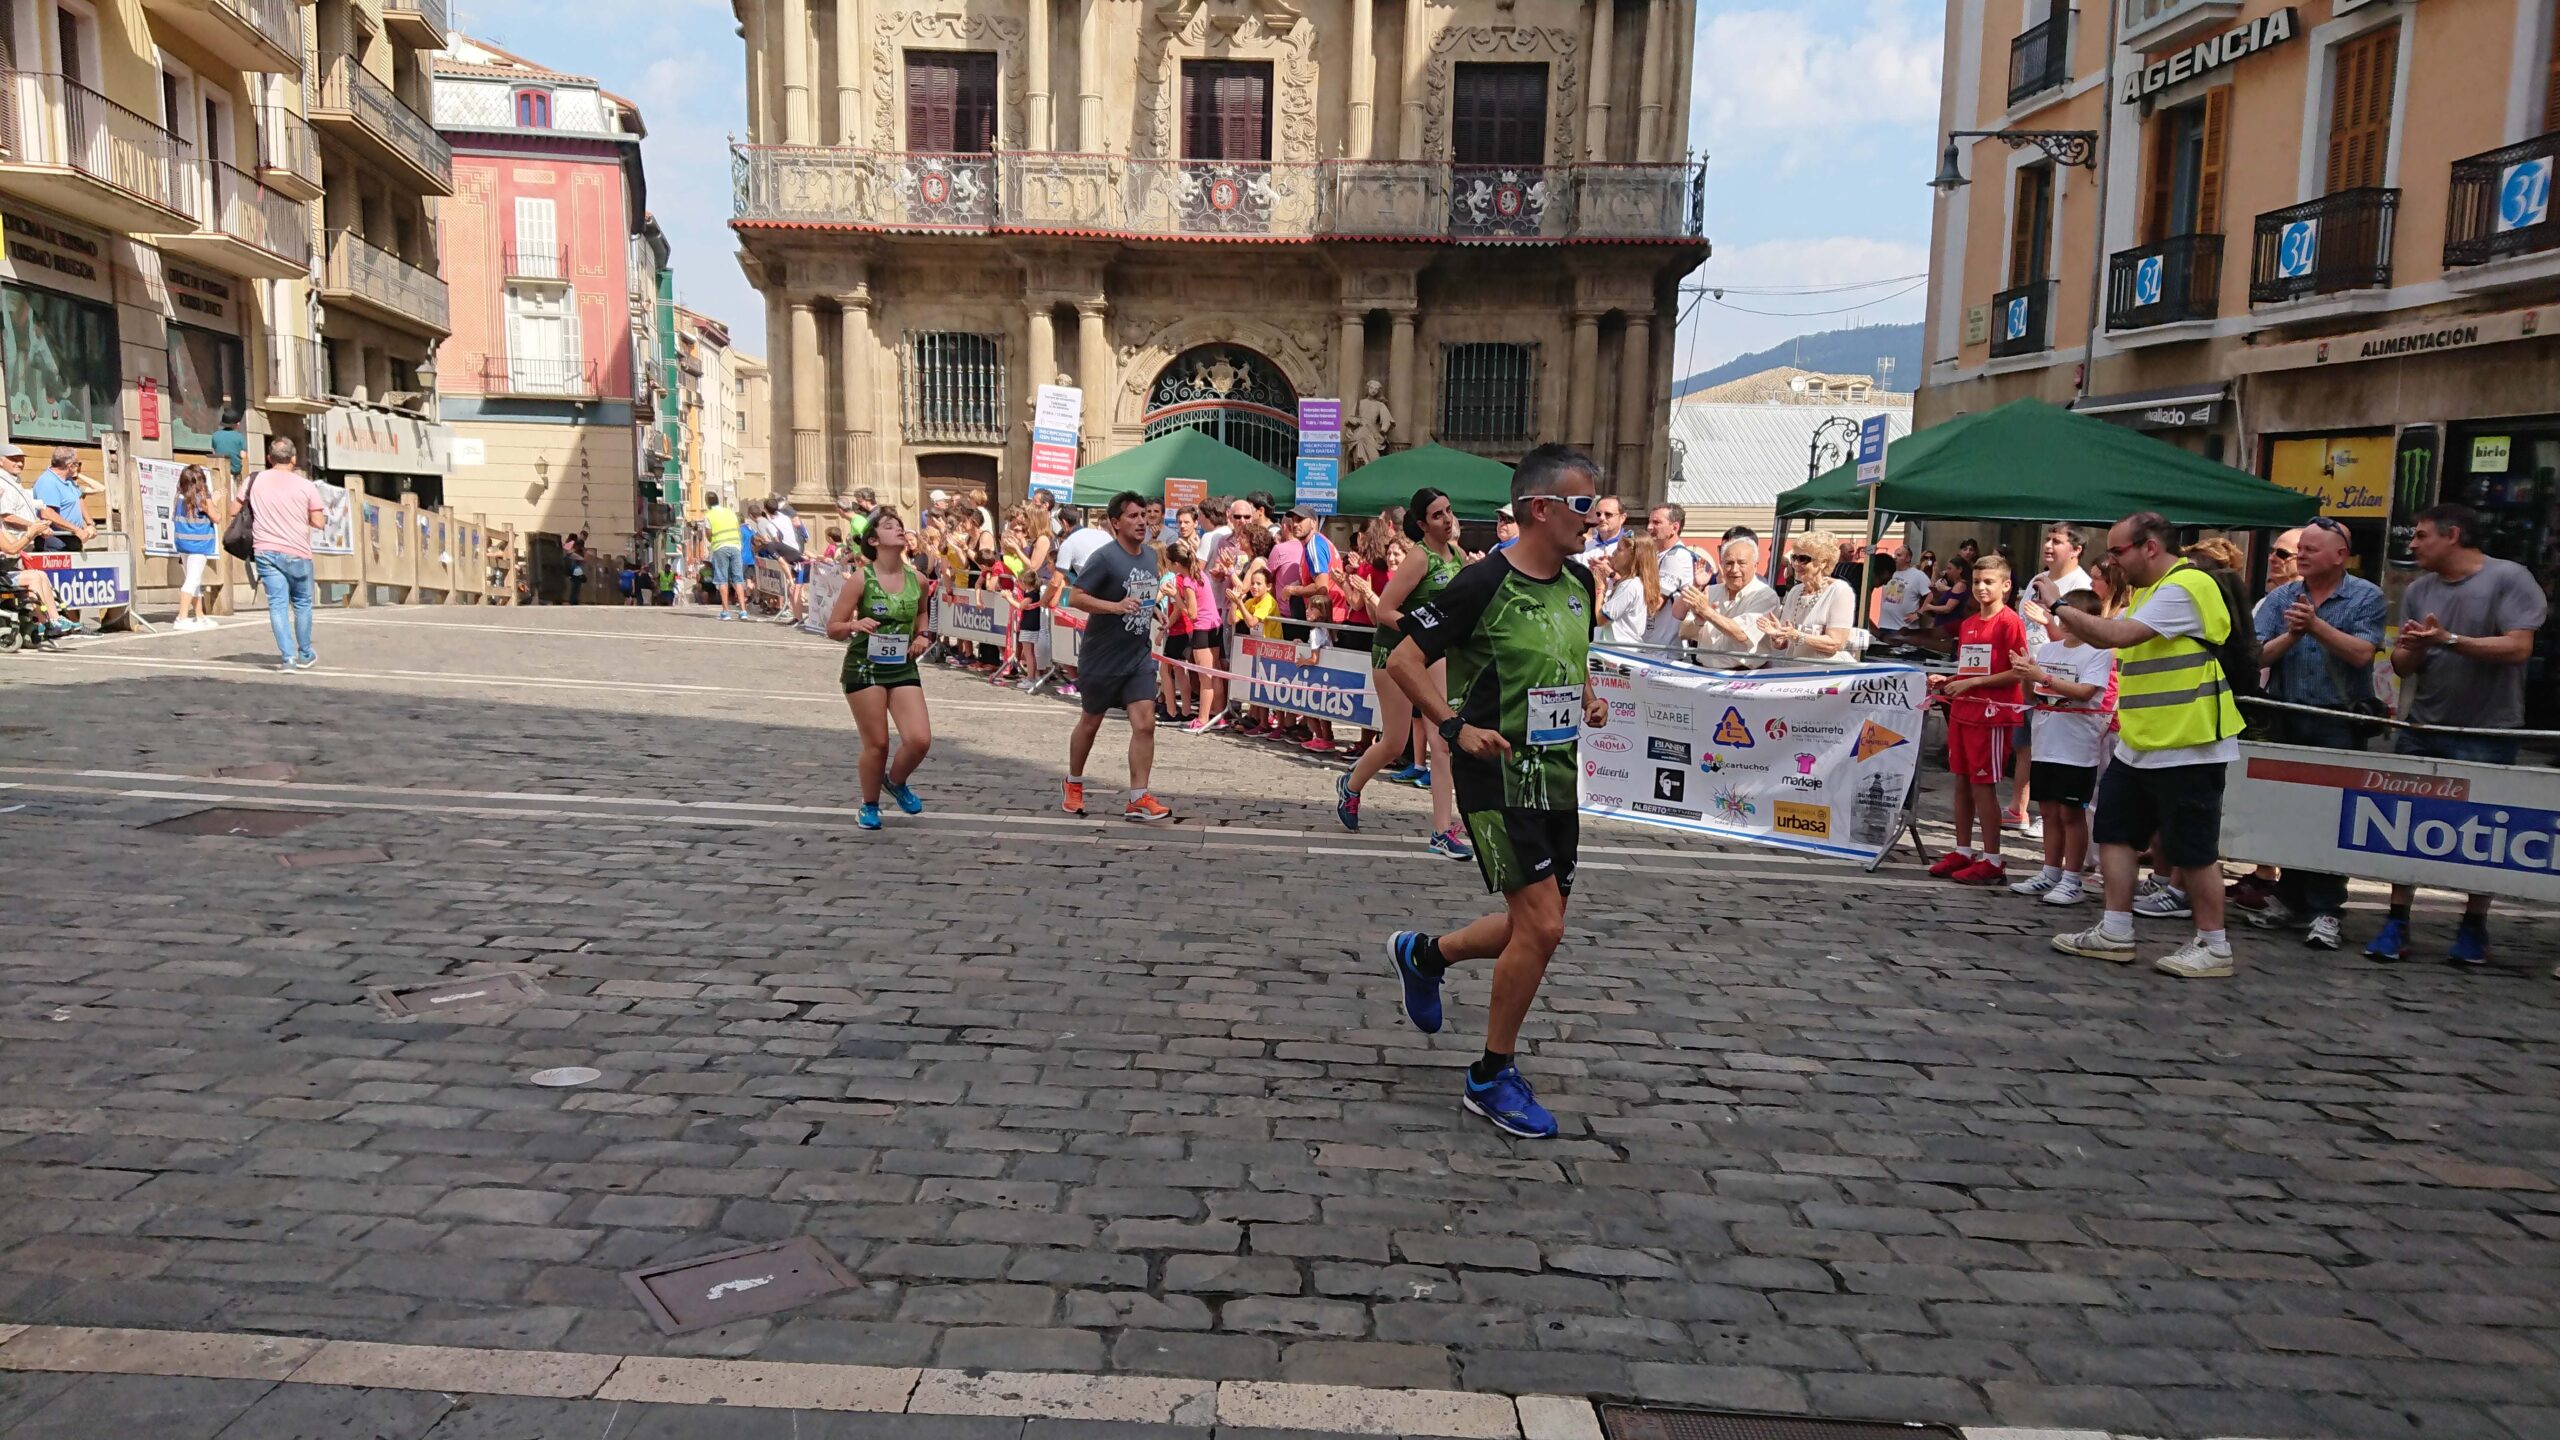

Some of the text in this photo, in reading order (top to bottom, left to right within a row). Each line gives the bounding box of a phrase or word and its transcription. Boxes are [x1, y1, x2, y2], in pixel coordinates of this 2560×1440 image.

[2120, 7, 2291, 104] AGENCIA
[2511, 168, 2548, 224] 31
[2287, 229, 2313, 272] 31
[2139, 265, 2161, 301] 31
[2011, 303, 2026, 336] 31
[2360, 326, 2479, 357] ALIMENTACION
[2336, 485, 2383, 509] Lilian
[42, 555, 71, 568] Diario de
[1140, 590, 1151, 600] 44
[954, 605, 992, 631] Noticias
[881, 646, 898, 656] 58
[1259, 642, 1294, 661] Diario de
[1968, 656, 1980, 667] 13
[1254, 661, 1354, 718] Noticias
[1851, 675, 1909, 693] IRUÑA
[1610, 701, 1636, 710] canal
[1850, 691, 1914, 711] ZARRA
[1549, 708, 1570, 728] 14
[1615, 708, 1636, 717] cero
[1791, 725, 1844, 735] bidaurreta
[1593, 739, 1626, 750] AROMA
[1597, 766, 1629, 779] divertis
[1782, 775, 1823, 789] markaje
[2363, 770, 2464, 798] Diario de
[1633, 802, 1667, 814] ALBERTO
[1777, 814, 1826, 833] urbasa
